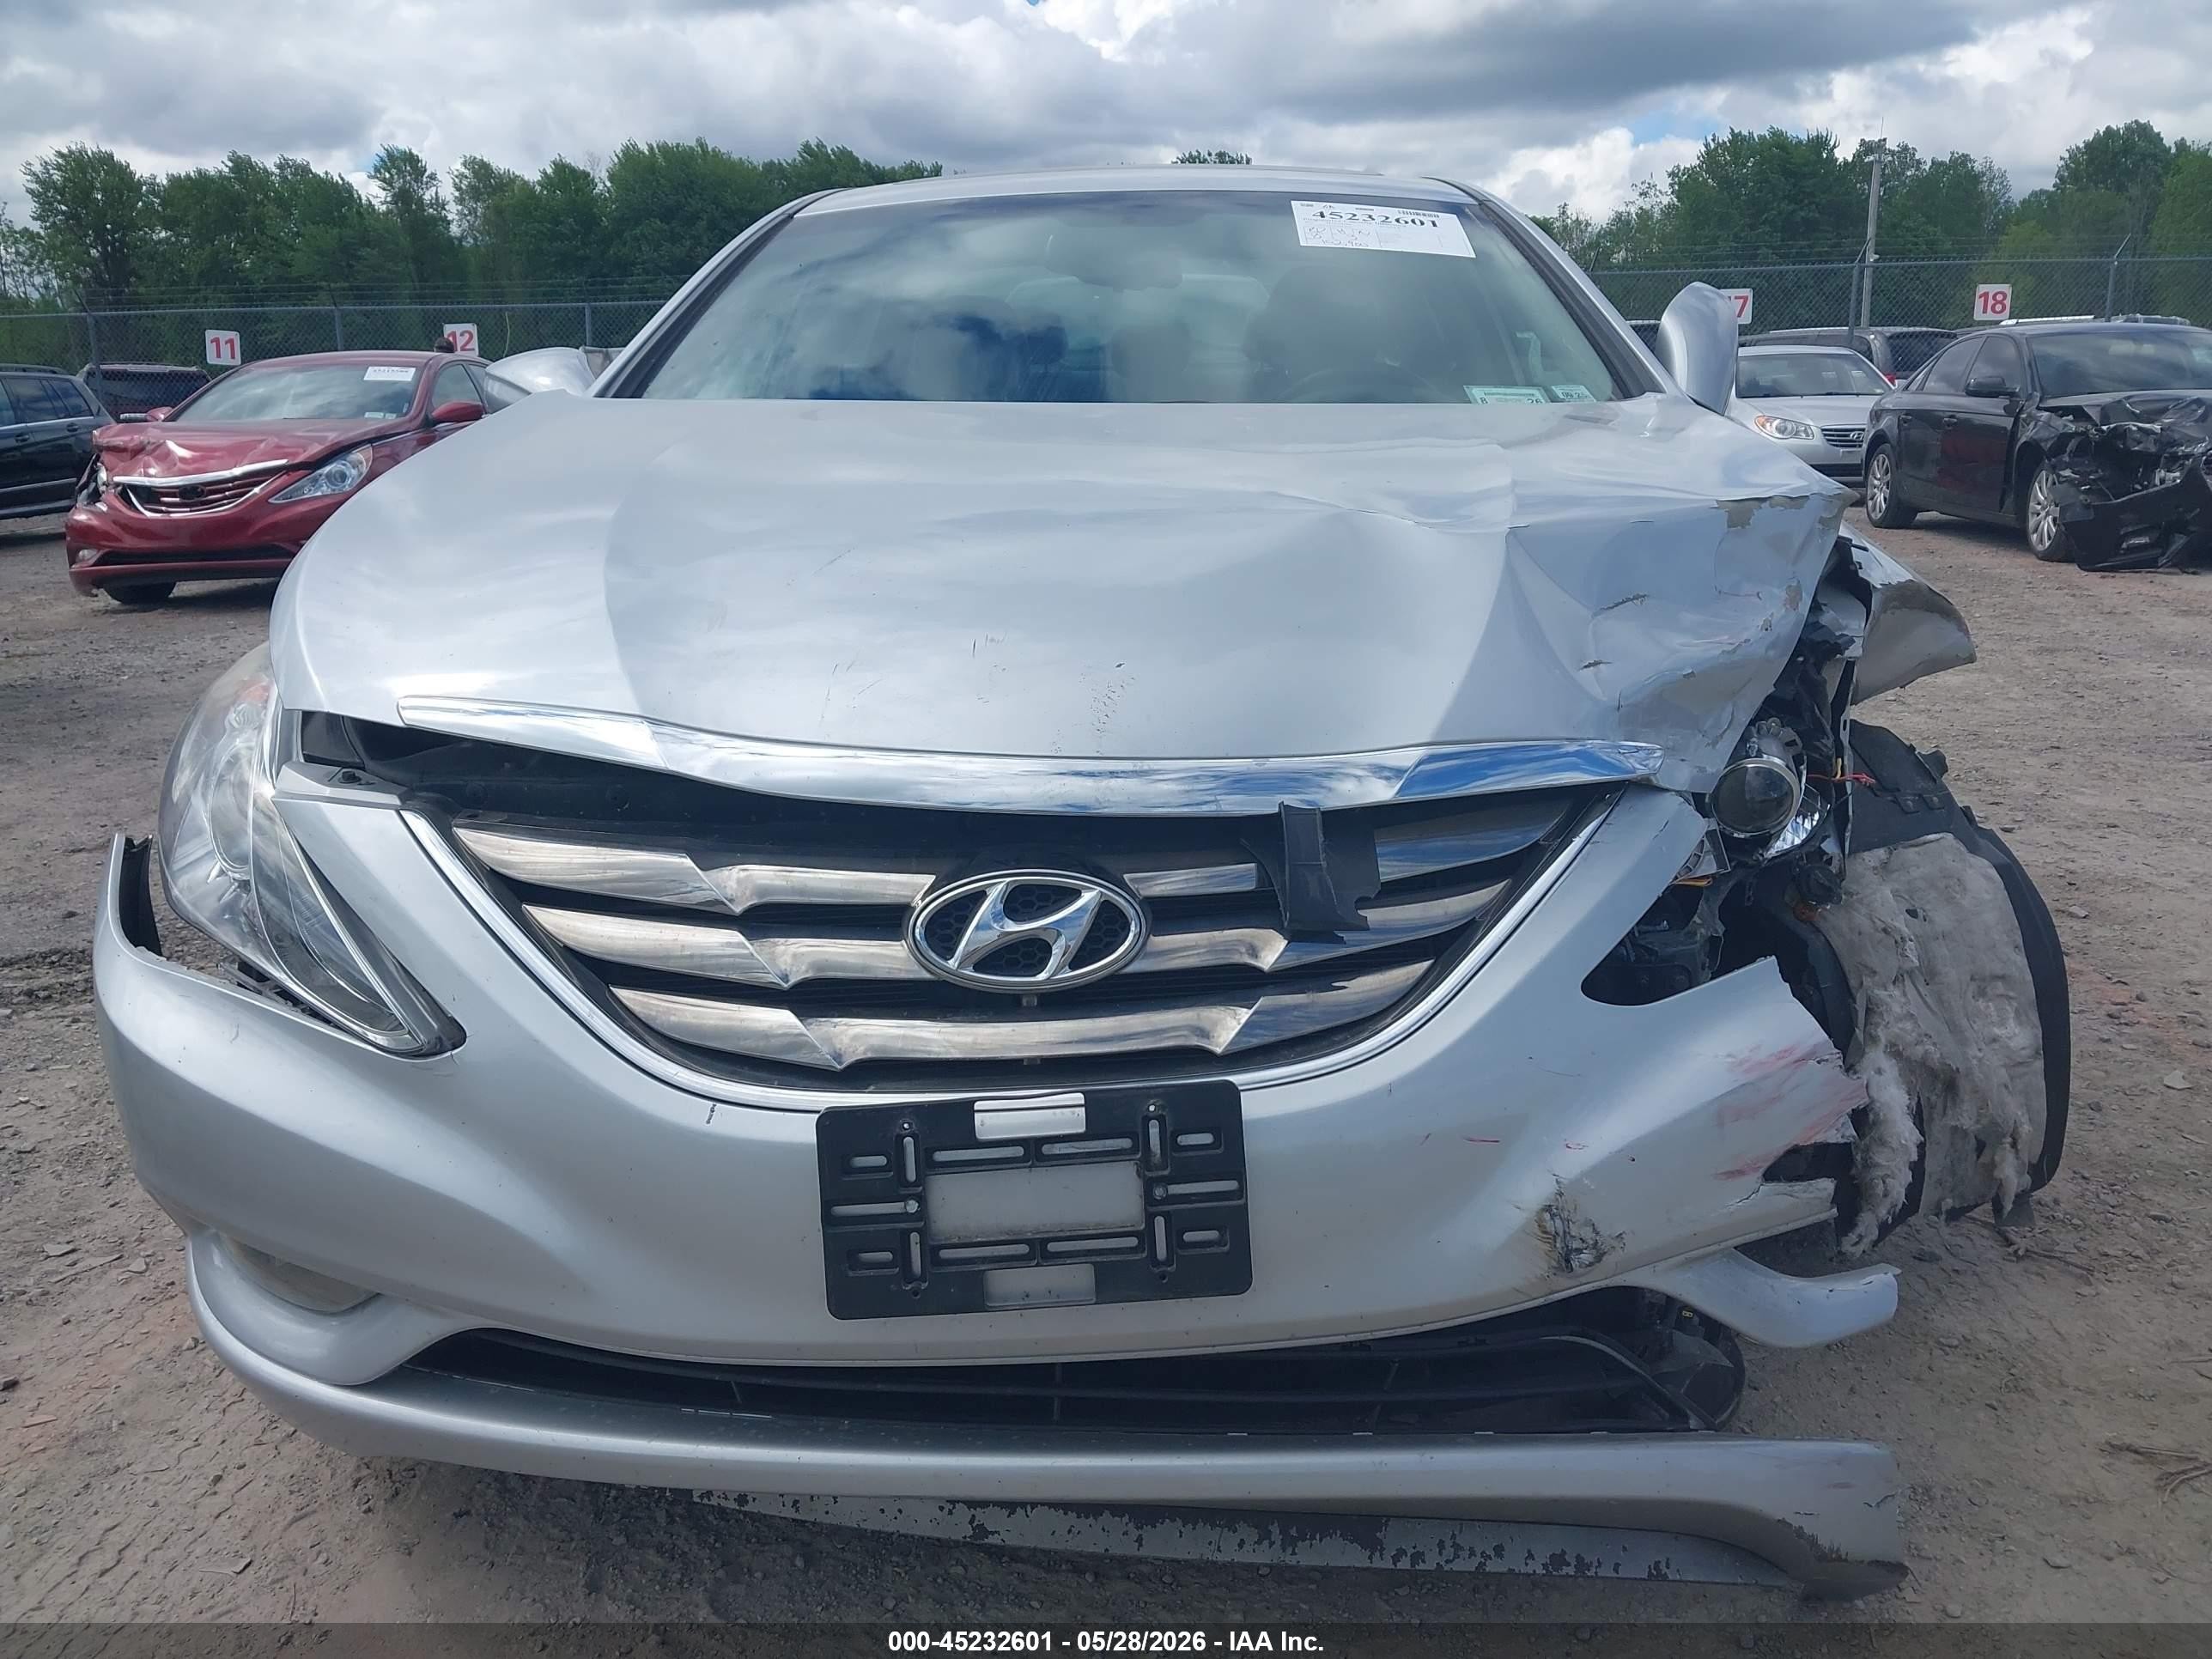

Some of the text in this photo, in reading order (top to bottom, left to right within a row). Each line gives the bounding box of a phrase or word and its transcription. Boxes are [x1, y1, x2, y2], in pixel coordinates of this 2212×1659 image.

[1312, 210, 1439, 228] 45232601
[1728, 295, 1749, 318] 7
[1978, 290, 2008, 315] 18
[210, 337, 236, 360] 11
[447, 330, 476, 352] 12
